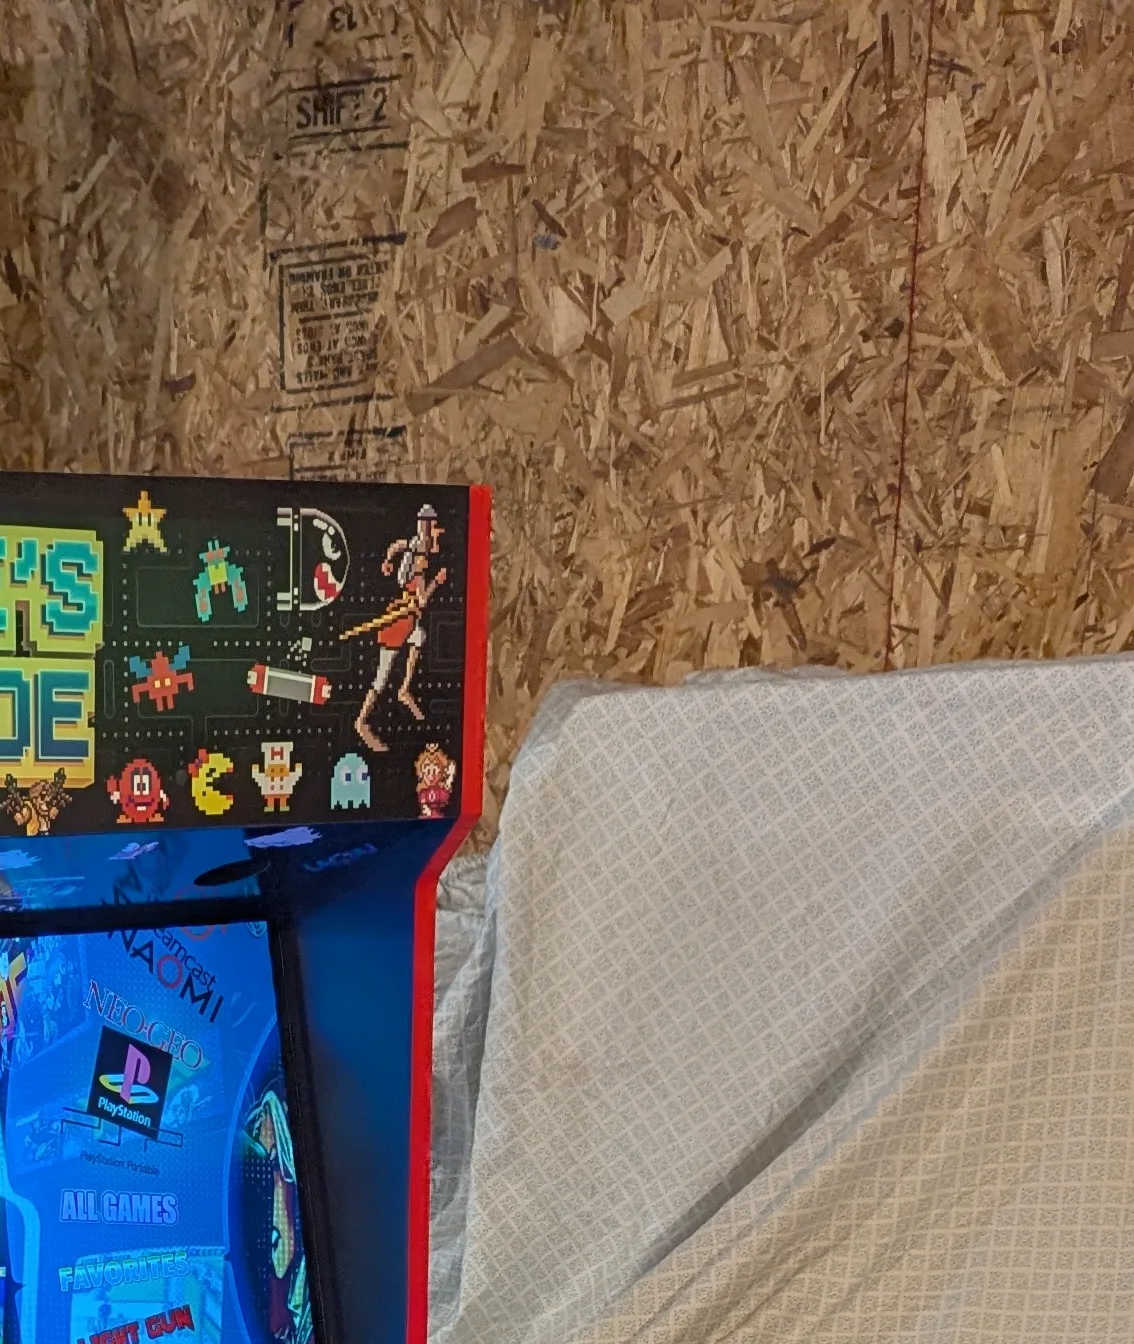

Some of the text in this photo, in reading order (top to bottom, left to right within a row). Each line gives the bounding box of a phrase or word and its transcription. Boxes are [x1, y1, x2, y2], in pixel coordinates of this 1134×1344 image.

[373, 88, 388, 121] 2
[97, 1096, 152, 1129] PlayStation
[79, 1150, 161, 1177] PlayStation Portable
[60, 1189, 179, 1228] ALL GAMES
[59, 1250, 191, 1292] FAVORITES
[144, 1304, 195, 1339] GUN
